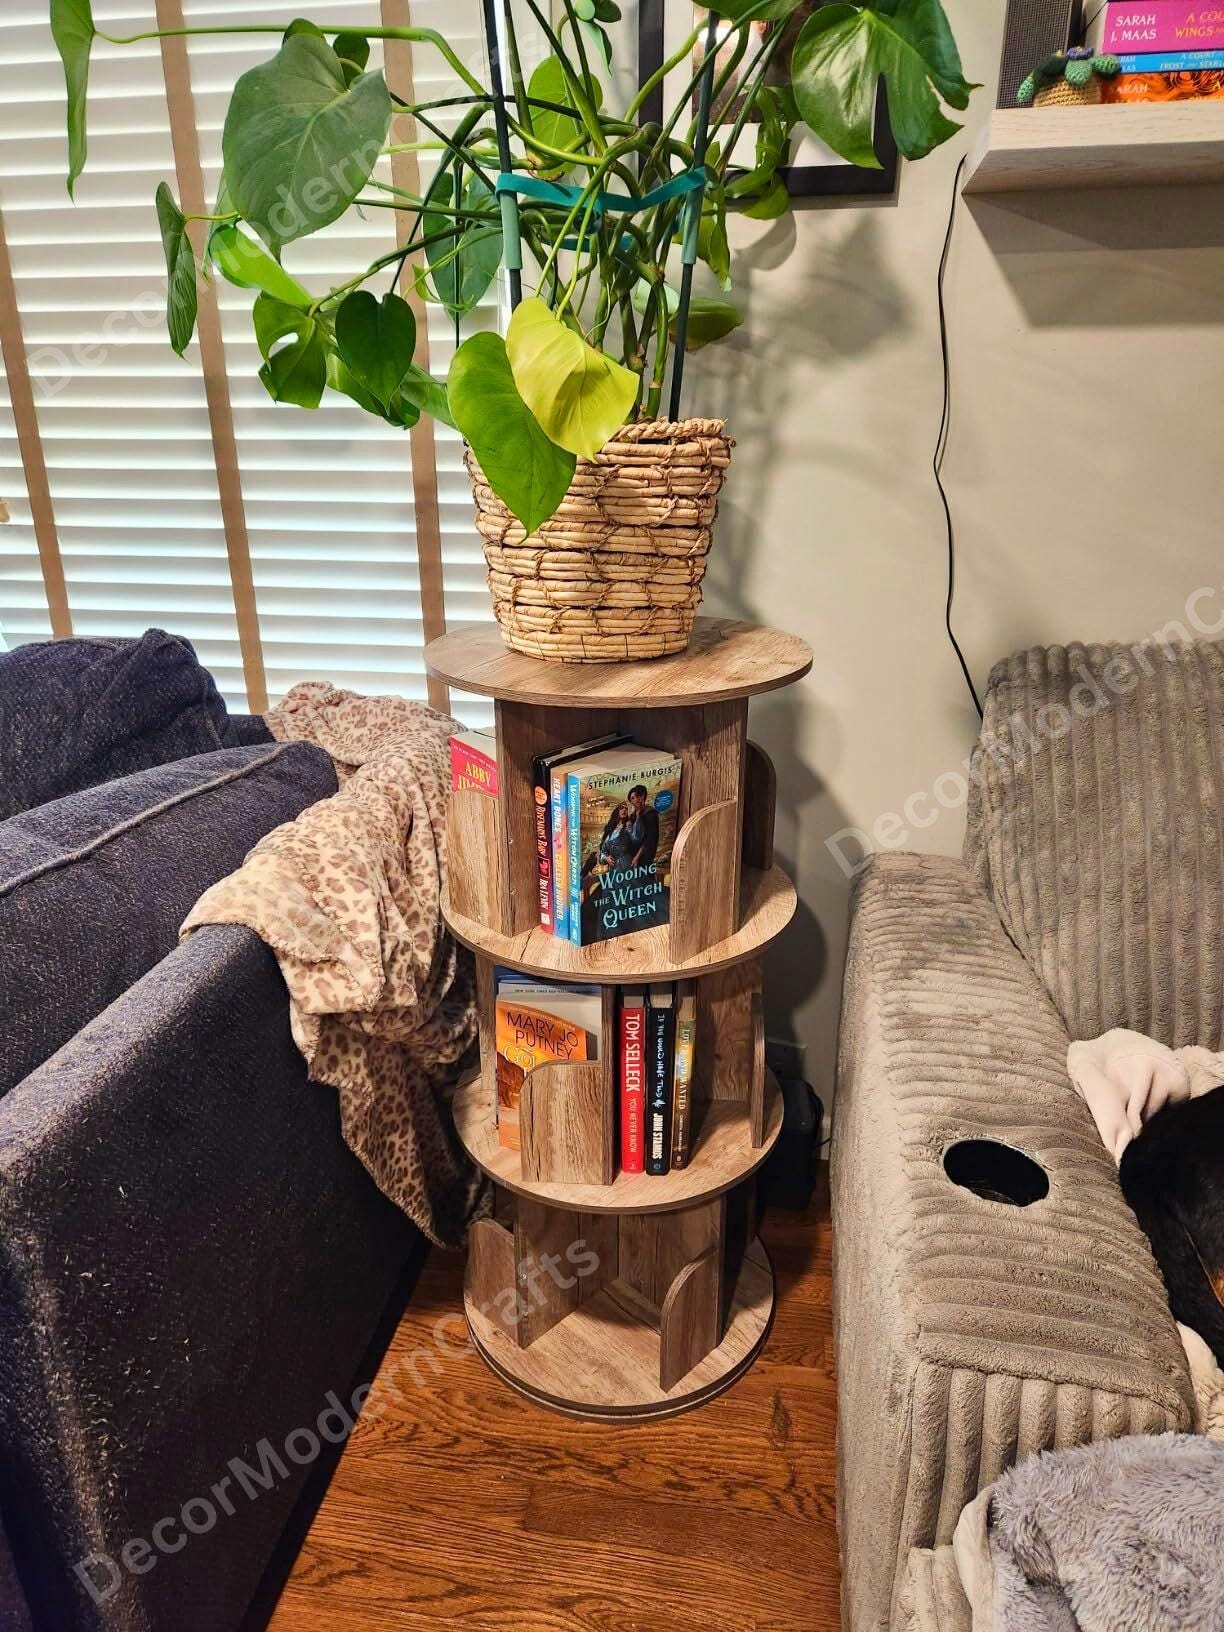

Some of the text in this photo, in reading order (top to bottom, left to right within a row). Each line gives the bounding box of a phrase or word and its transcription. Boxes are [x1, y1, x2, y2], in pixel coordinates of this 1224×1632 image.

[1116, 14, 1156, 27] SARAH
[1186, 13, 1195, 24] A
[1122, 29, 1157, 41] MAAS
[1175, 26, 1213, 39] WINGS
[465, 761, 491, 787] ABBY
[588, 766, 673, 790] STEPHANIE BURGIS
[553, 778, 562, 832] HEART BONES
[598, 863, 657, 890] WOOING
[593, 882, 662, 908] THE WITCH
[603, 901, 657, 929] QUEEN
[507, 1011, 554, 1037] MARY
[560, 1029, 579, 1047] JO
[515, 1030, 573, 1060] PUTNEY
[625, 1014, 640, 1092] TOM SELLECK
[679, 1077, 688, 1110] WANTED
[629, 1098, 638, 1153] YOU NEVER KNOW
[652, 1113, 663, 1159] JOHN STAMOS
